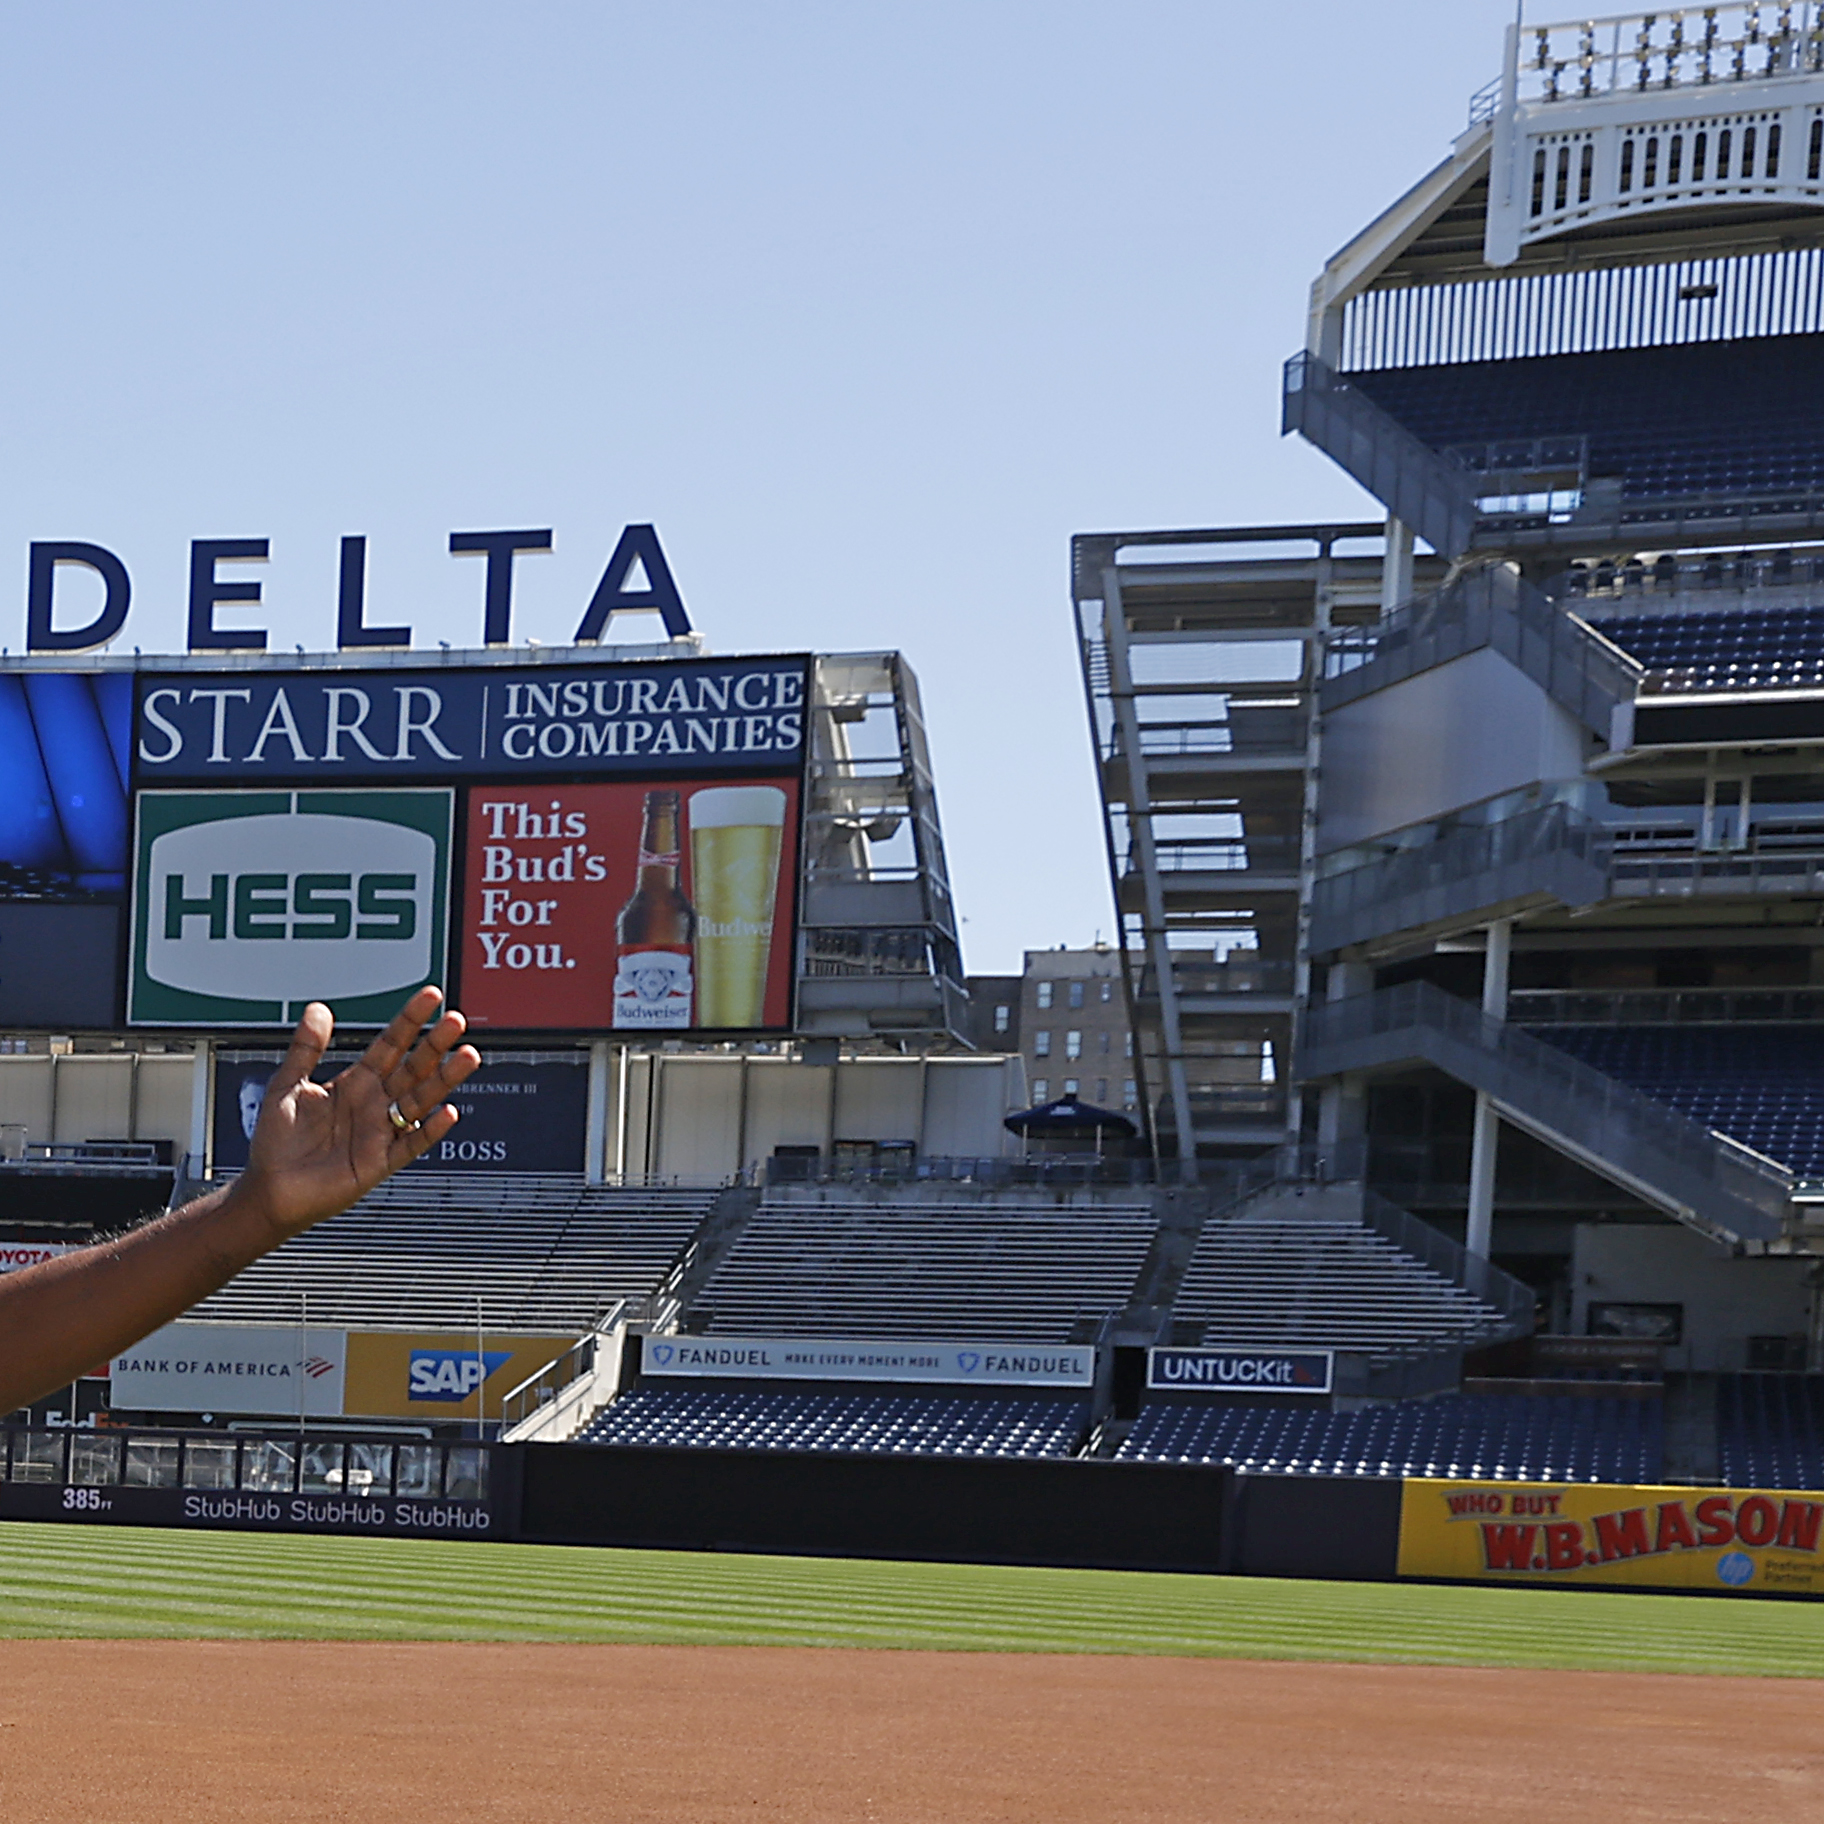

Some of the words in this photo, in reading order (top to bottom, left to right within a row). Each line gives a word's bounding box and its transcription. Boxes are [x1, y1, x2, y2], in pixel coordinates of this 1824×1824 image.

[29, 522, 693, 654] DELTA
[504, 672, 804, 719] INSURANCE
[139, 686, 462, 765] STARR
[503, 713, 801, 759] COMPANIES
[482, 801, 587, 839] This
[481, 844, 608, 882] Bud's
[163, 873, 418, 940] HESS
[479, 889, 558, 926] For
[476, 932, 577, 969] You.
[617, 1004, 689, 1020] Budweiser
[441, 1140, 507, 1161] BOSS
[118, 1359, 170, 1373] BANK
[175, 1360, 200, 1374] OF
[204, 1361, 292, 1378] AMERICA
[409, 1357, 487, 1394] SAP
[680, 1348, 771, 1367] FANDUEL
[984, 1355, 1084, 1375] FANDUEL
[1163, 1356, 1293, 1384] UNTUCKit
[184, 1494, 281, 1521] StubHub
[289, 1498, 385, 1525] StubHub
[394, 1503, 490, 1530] StubHub
[1447, 1493, 1504, 1515] WHO
[1512, 1494, 1563, 1515] BUT
